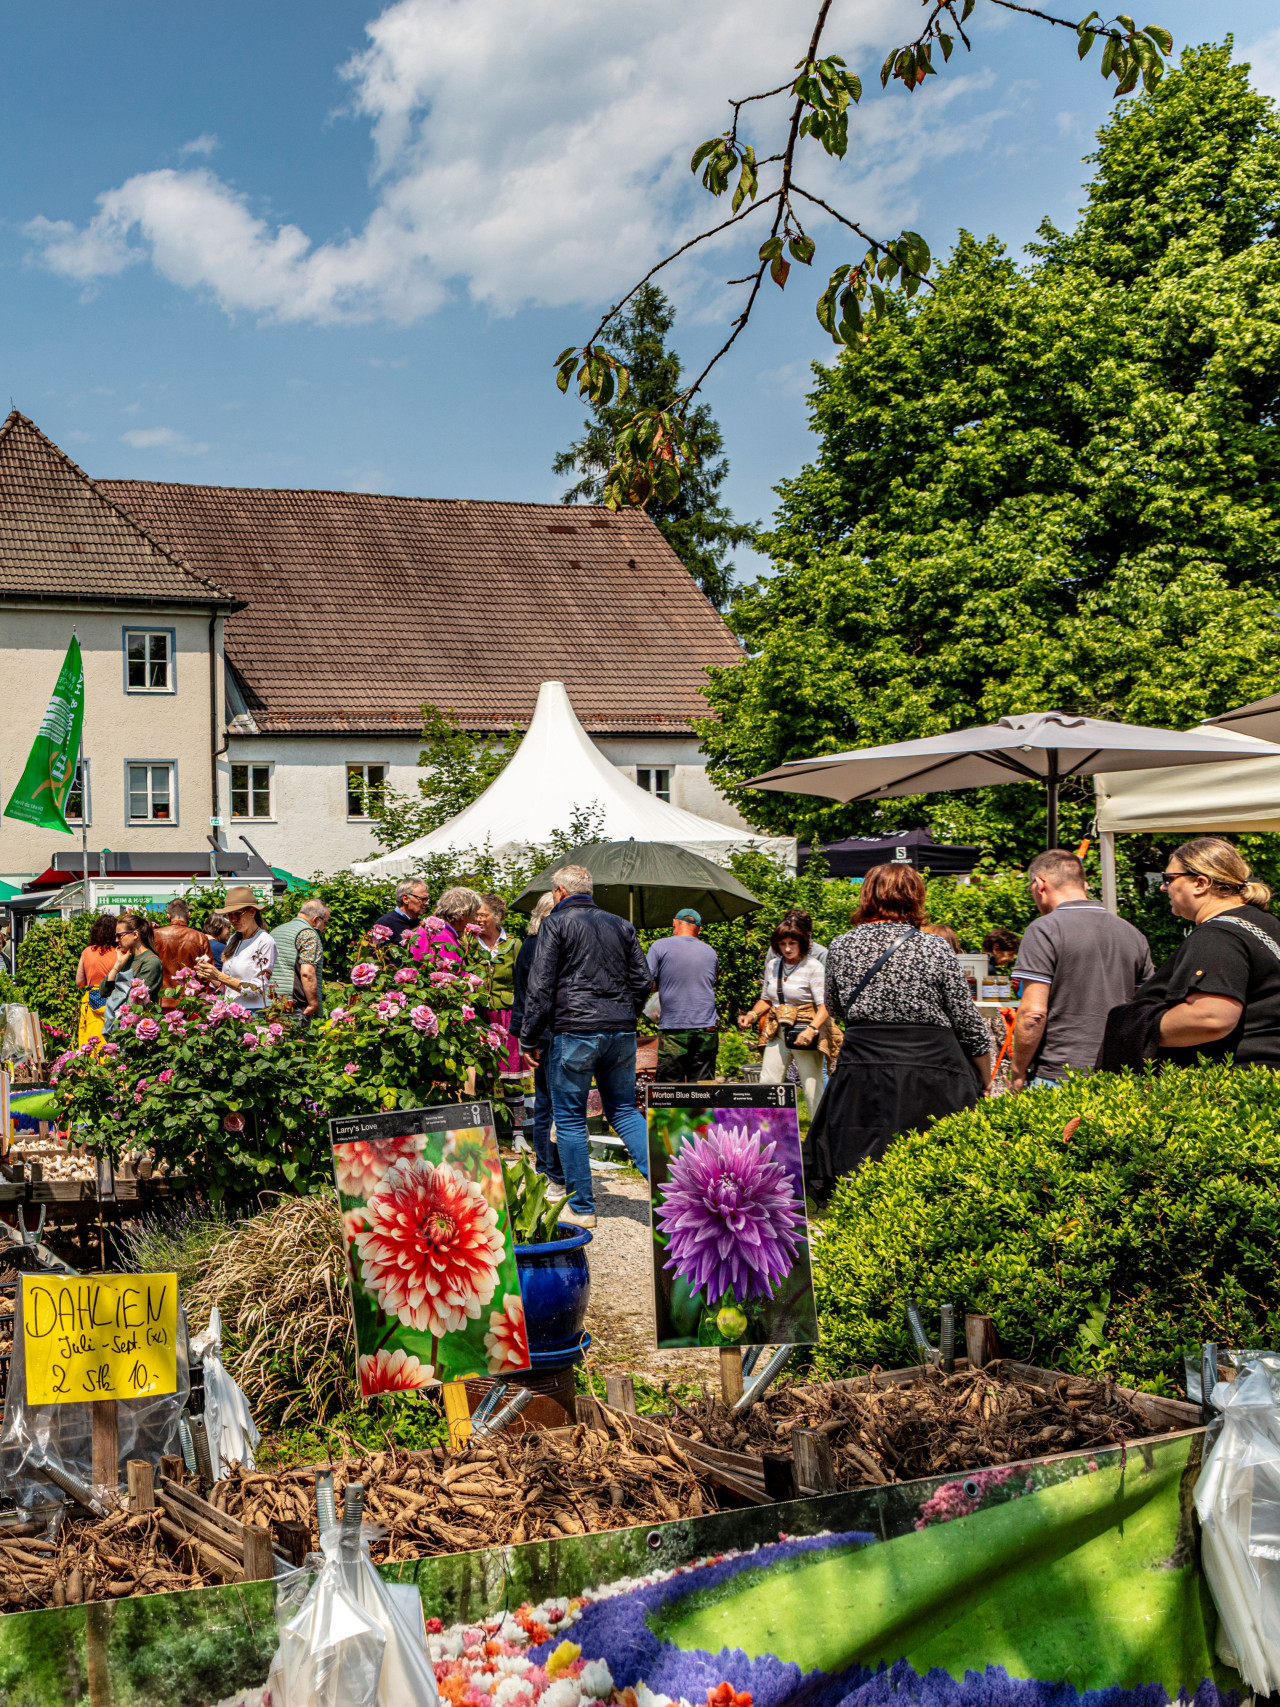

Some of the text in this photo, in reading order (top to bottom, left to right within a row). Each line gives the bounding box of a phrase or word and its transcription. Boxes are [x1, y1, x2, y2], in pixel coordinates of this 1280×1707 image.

[652, 1091, 711, 1099] Worton Blue Streak
[336, 1123, 378, 1135] Larry's Love
[58, 1335, 96, 1359] Juli
[52, 1364, 71, 1393] 2
